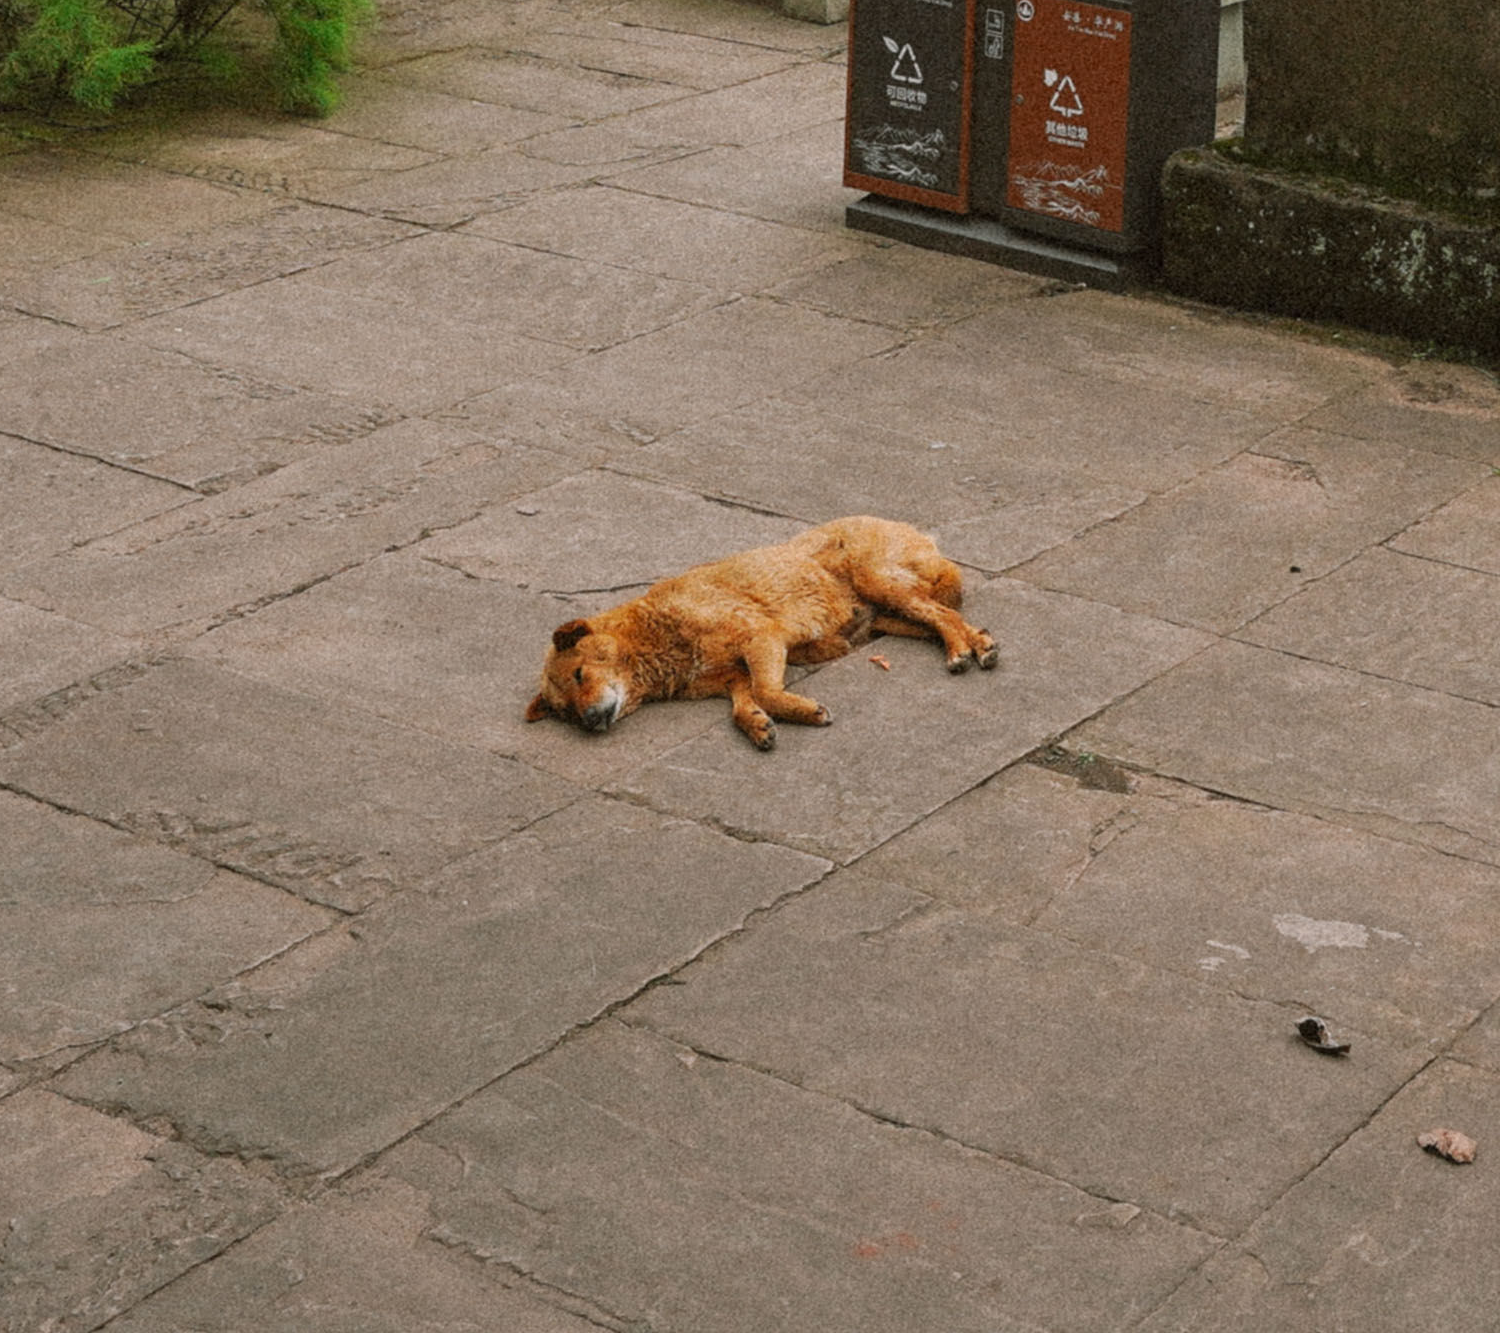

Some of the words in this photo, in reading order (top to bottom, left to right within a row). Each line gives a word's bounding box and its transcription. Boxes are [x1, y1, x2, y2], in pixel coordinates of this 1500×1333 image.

[886, 85, 928, 105] 可回收物
[1045, 120, 1089, 141] 其他垃圾
